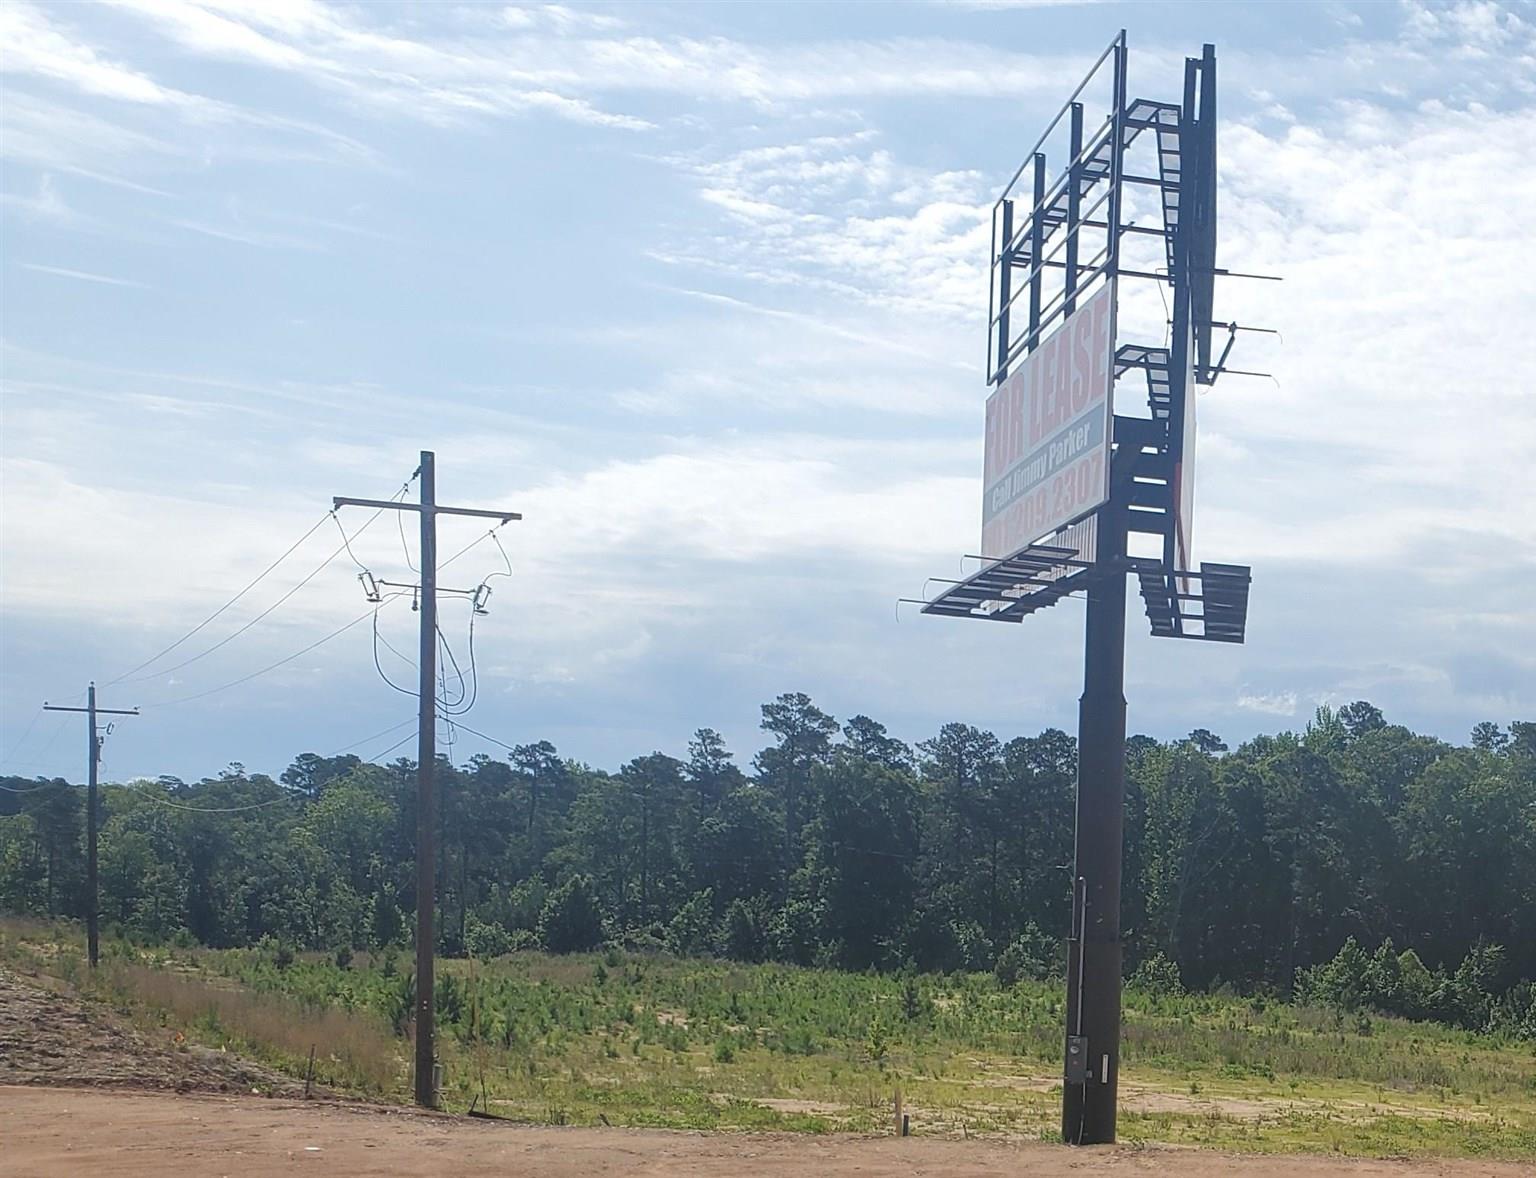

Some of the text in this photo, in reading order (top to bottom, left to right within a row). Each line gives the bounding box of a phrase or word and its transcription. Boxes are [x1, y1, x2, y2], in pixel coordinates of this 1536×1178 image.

[986, 297, 1109, 480] FOR LEASE
[991, 421, 1090, 513] Call Jimmy Parker
